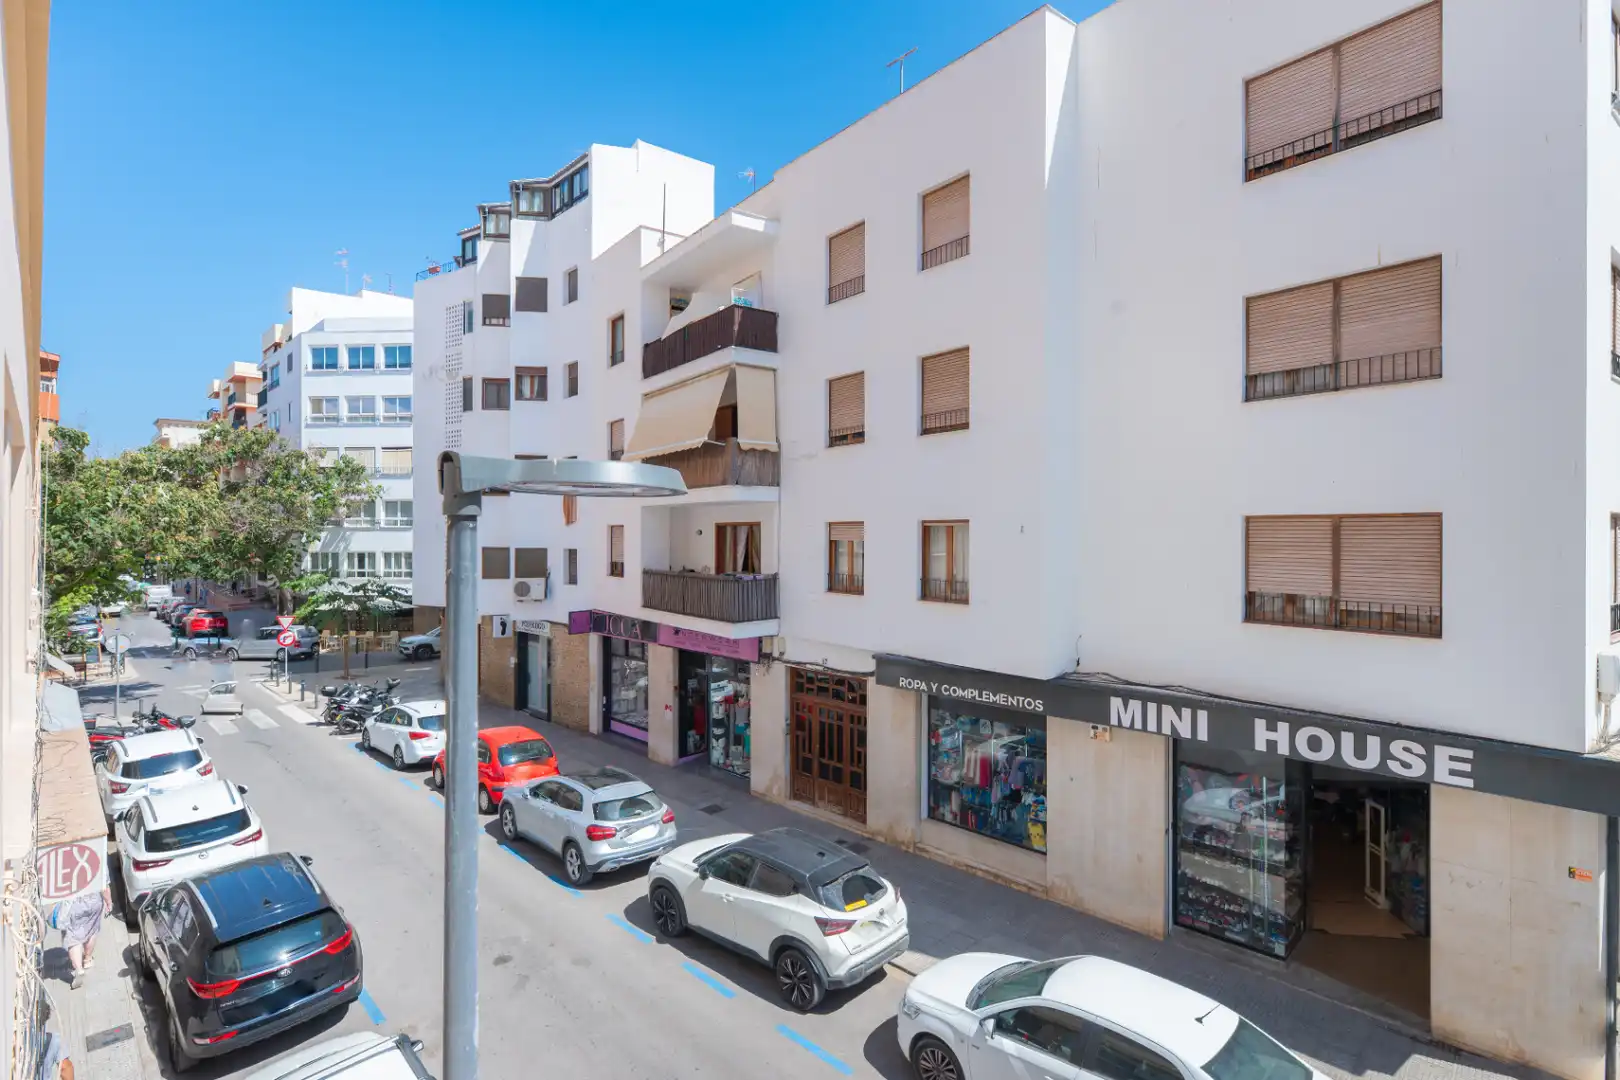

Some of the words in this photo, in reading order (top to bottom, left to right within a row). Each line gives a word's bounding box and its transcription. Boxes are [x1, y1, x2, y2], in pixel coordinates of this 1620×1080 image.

[899, 677, 928, 692] ROPA
[930, 682, 938, 693] Y
[941, 684, 1044, 712] COMPLEMENTOS
[1109, 696, 1208, 741] MINI
[1254, 718, 1475, 788] HOUSE
[38, 846, 92, 897] ALEX
